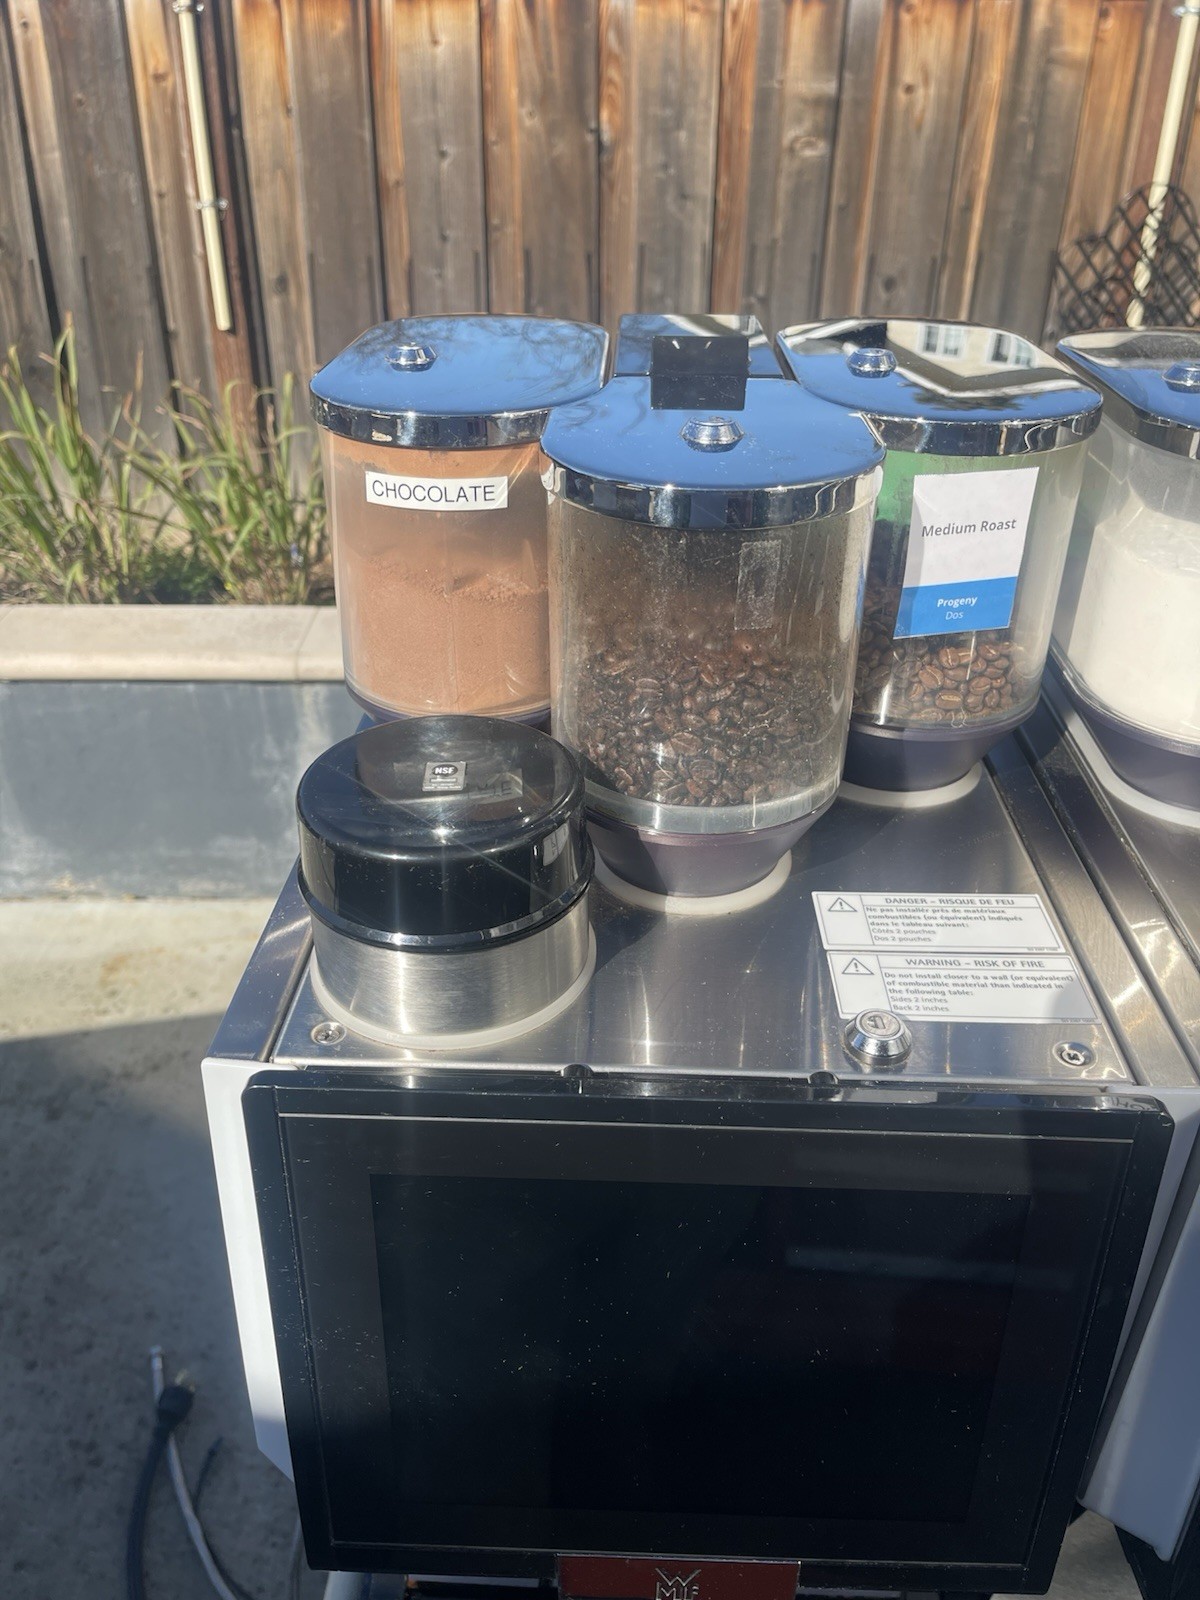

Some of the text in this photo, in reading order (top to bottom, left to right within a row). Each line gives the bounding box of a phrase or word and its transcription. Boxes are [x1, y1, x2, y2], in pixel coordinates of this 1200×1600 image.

[372, 479, 496, 503] CHOCOLATE
[921, 518, 1017, 538] Medium Roast
[936, 596, 978, 608] Progeny
[945, 611, 964, 620] Dos
[434, 766, 456, 775] NSF
[884, 897, 928, 905] DANGER
[995, 898, 1015, 906] FEU
[905, 958, 961, 966] WARNING
[973, 959, 999, 967] RISK
[1002, 959, 1018, 967] OF
[1020, 960, 1045, 968] FIRE
[905, 988, 946, 996] following
